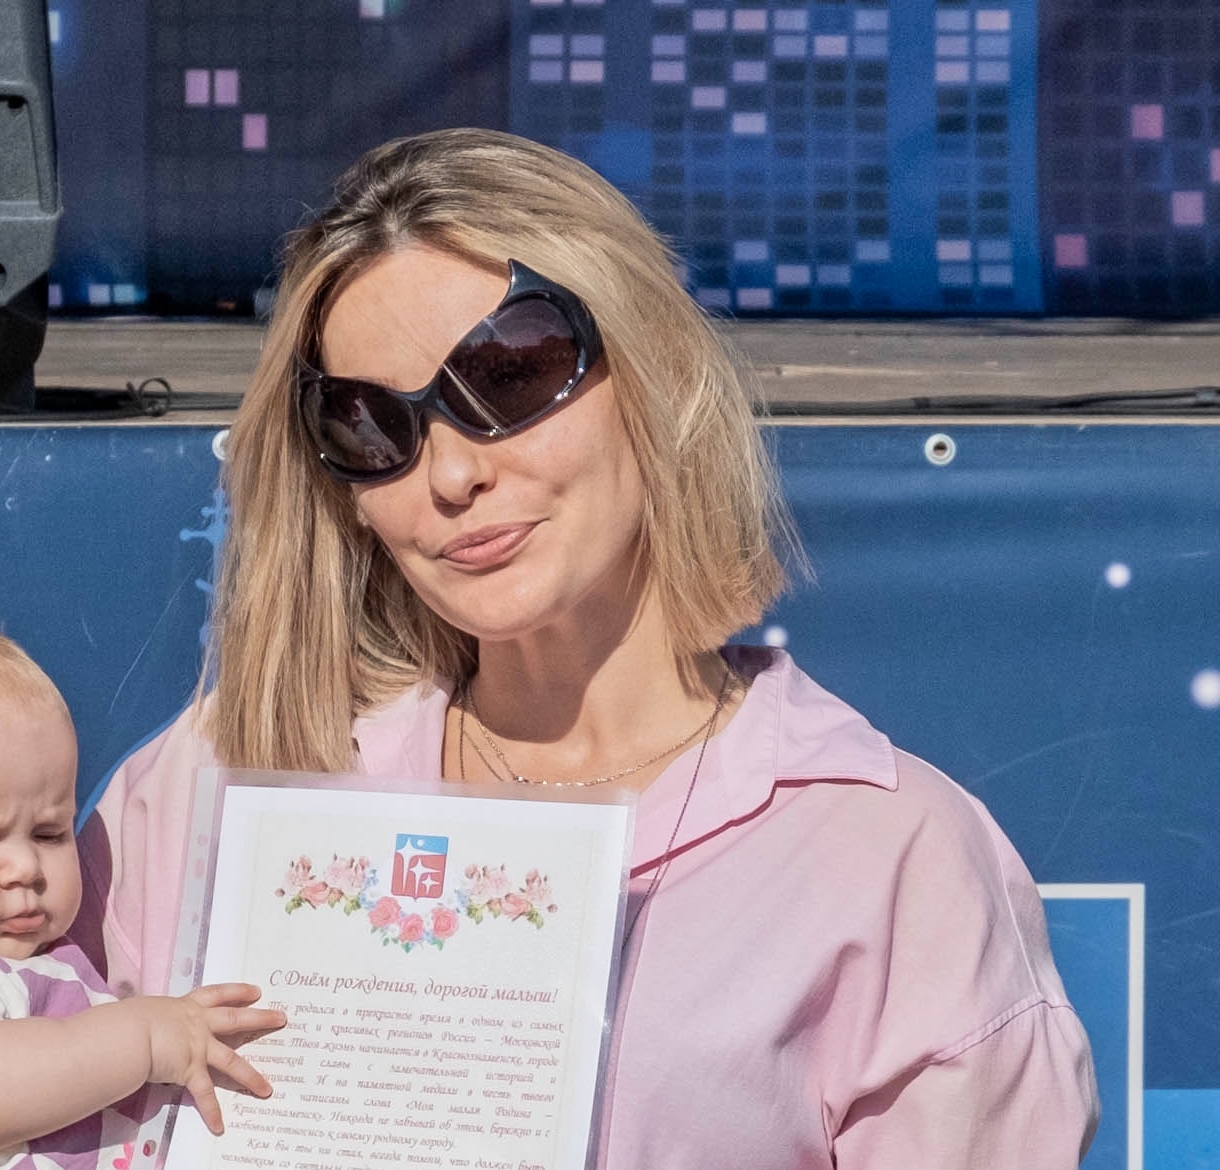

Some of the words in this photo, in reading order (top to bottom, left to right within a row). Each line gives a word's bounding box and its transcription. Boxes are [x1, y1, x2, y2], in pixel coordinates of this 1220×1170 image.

[270, 969, 283, 987] С
[284, 969, 330, 988] Днём
[334, 975, 418, 996] рождения,
[424, 978, 488, 1002] дорогой
[492, 986, 557, 1003] малыш!
[295, 1003, 335, 1017] родился
[356, 1009, 413, 1022] прекрасное
[419, 1013, 451, 1025] время
[471, 1014, 504, 1027] одном
[530, 1022, 565, 1034] самых
[290, 1037, 320, 1048] Твоя
[322, 1042, 356, 1051] жизнь
[358, 1045, 420, 1056] начинается
[331, 1025, 380, 1038] красивых
[387, 1029, 433, 1040] регионов
[440, 1031, 476, 1042] России
[501, 1035, 561, 1050] Московской
[299, 1093, 350, 1104] написаны
[363, 1098, 392, 1108] слова
